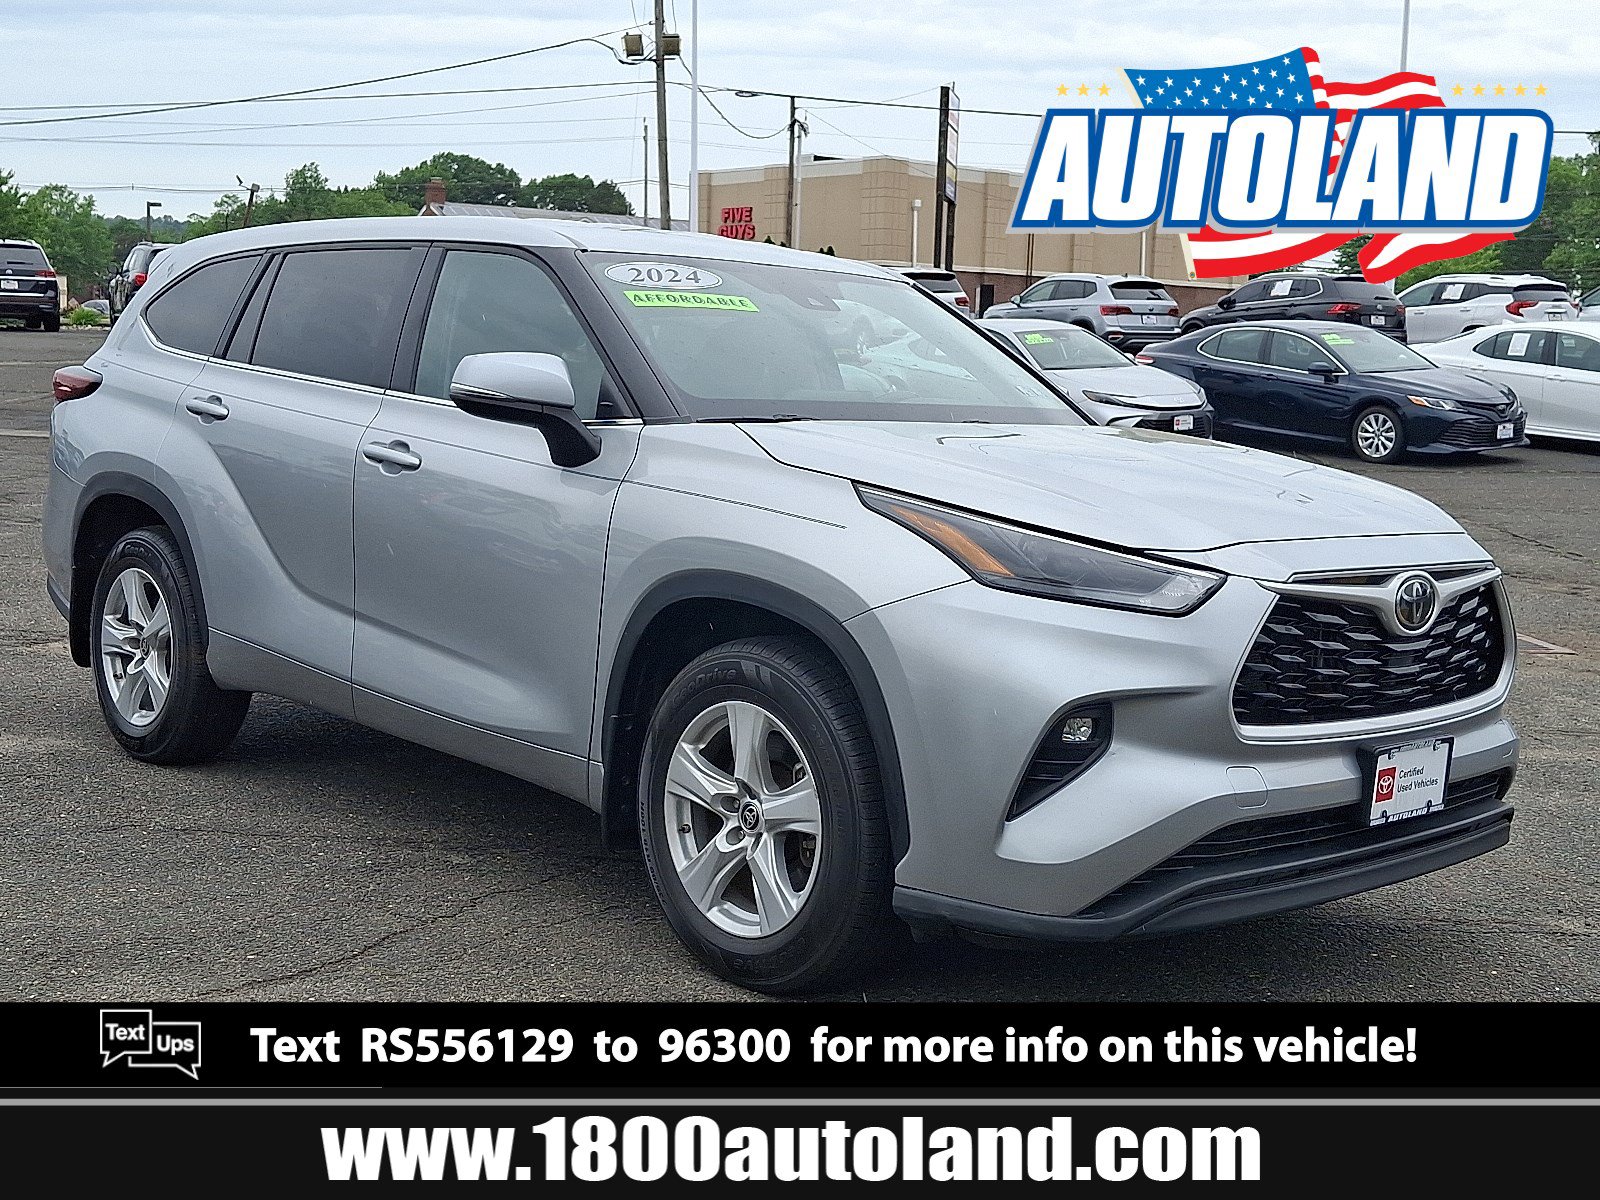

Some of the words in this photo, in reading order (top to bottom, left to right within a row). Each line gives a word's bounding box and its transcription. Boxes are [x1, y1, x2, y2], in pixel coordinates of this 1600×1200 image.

[722, 206, 753, 223] FIVE
[719, 224, 756, 240] GUYS
[627, 267, 702, 284] 2024
[632, 293, 751, 308] AFFORDABLE
[1398, 765, 1425, 779] Certified
[1397, 781, 1413, 793] Used
[1413, 777, 1439, 790] Vehicles
[1387, 808, 1428, 822] AUTOLAND
